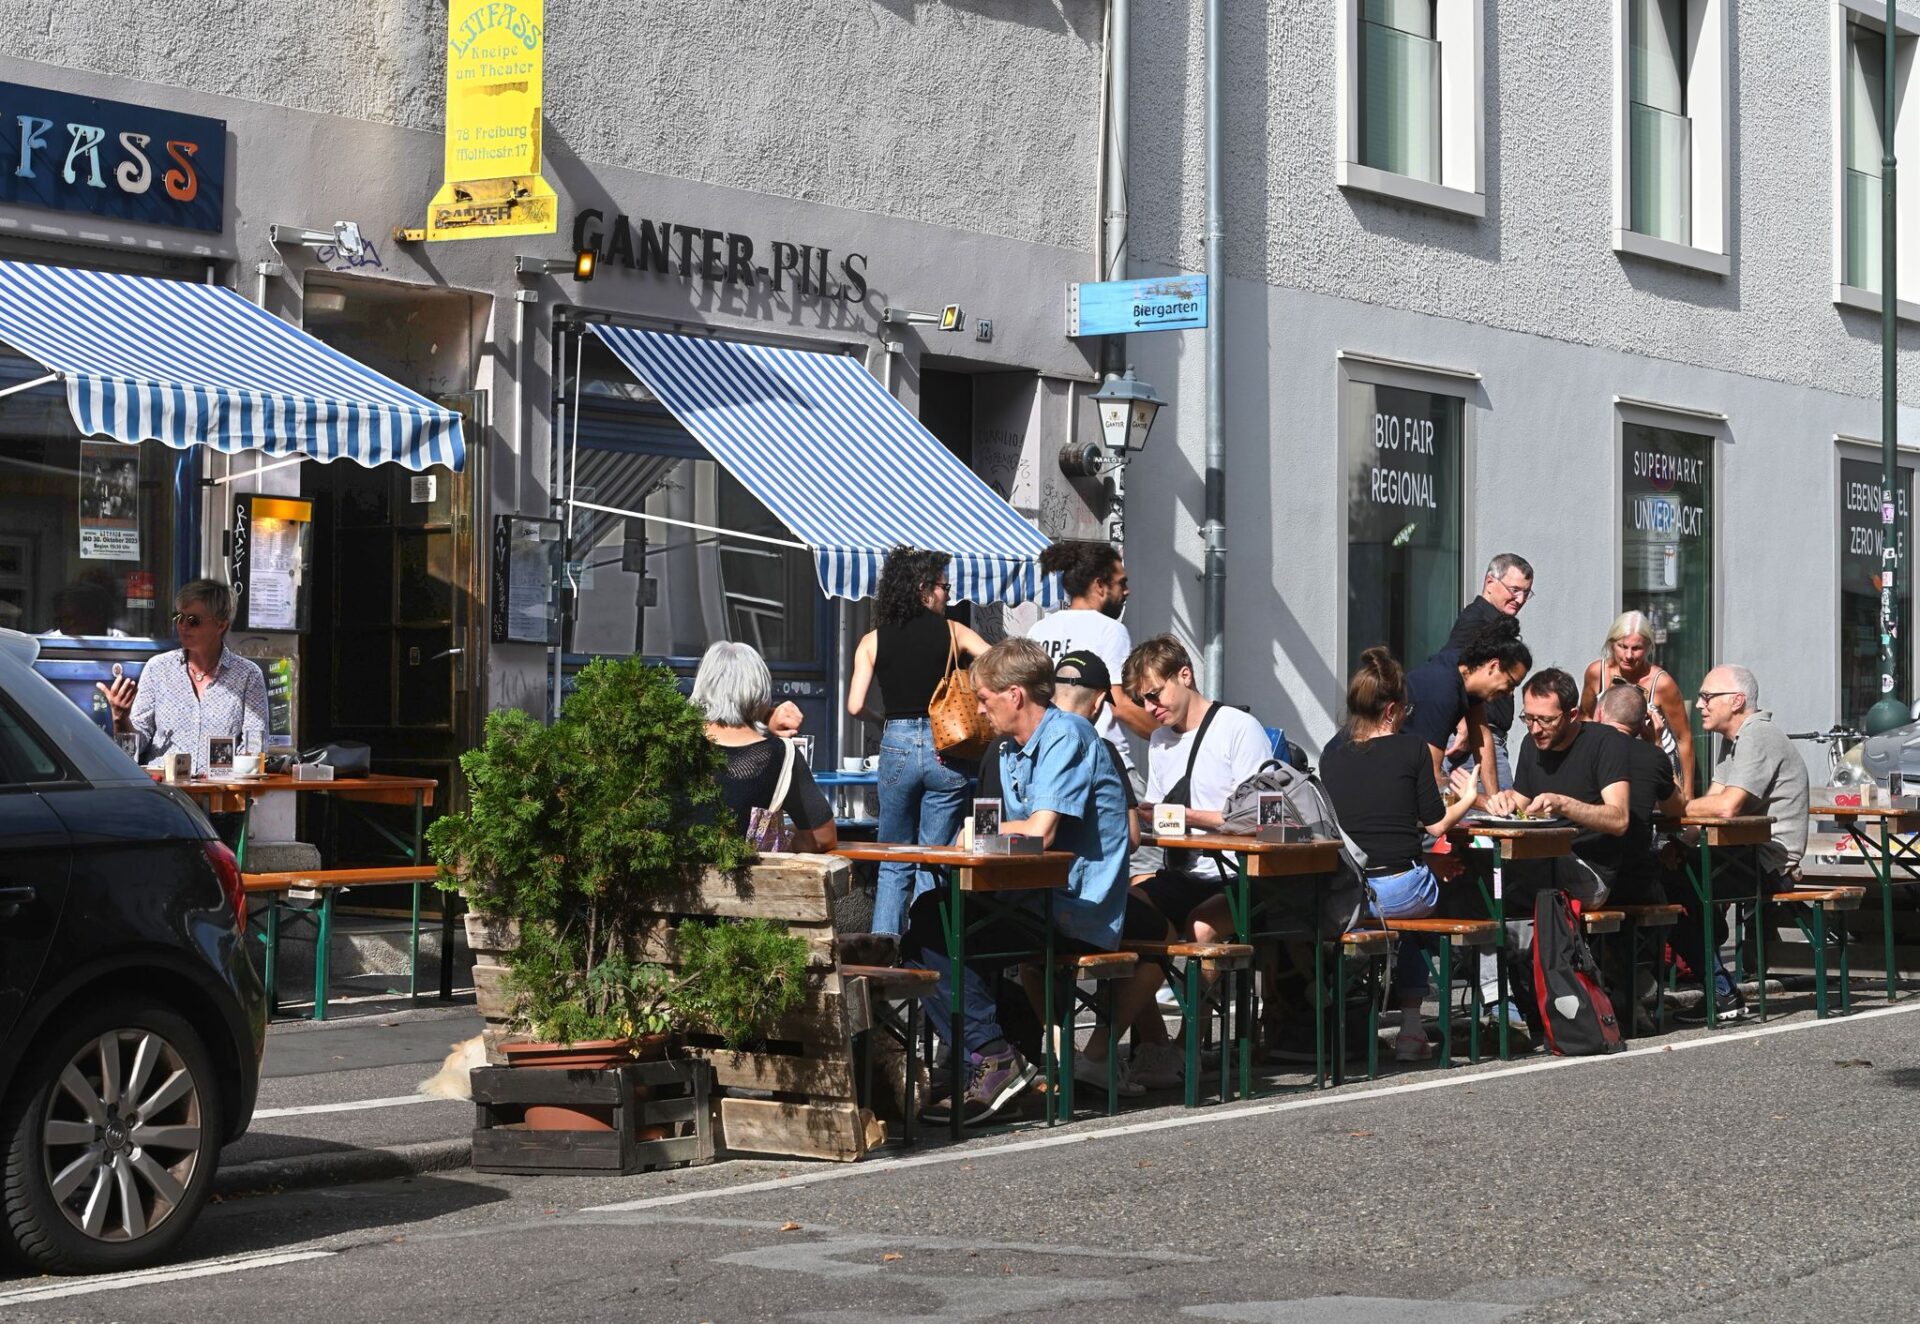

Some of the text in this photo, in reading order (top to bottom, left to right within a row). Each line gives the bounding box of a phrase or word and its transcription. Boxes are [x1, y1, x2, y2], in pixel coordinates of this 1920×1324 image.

[471, 46, 518, 60] Kneipe
[480, 63, 534, 77] Theater
[476, 126, 527, 140] Freiburg
[0, 113, 199, 202] FASS
[1133, 302, 1198, 317] Biergarten
[979, 322, 989, 338] 17
[1375, 413, 1434, 456] BIO FAIR
[1634, 451, 1703, 485] SUPERMARKT
[1371, 468, 1436, 508] REGIONAL
[1846, 482, 1908, 517] LEBENSEL
[1634, 500, 1703, 537] UNVERPACKT
[1850, 526, 1873, 556] ZERO
